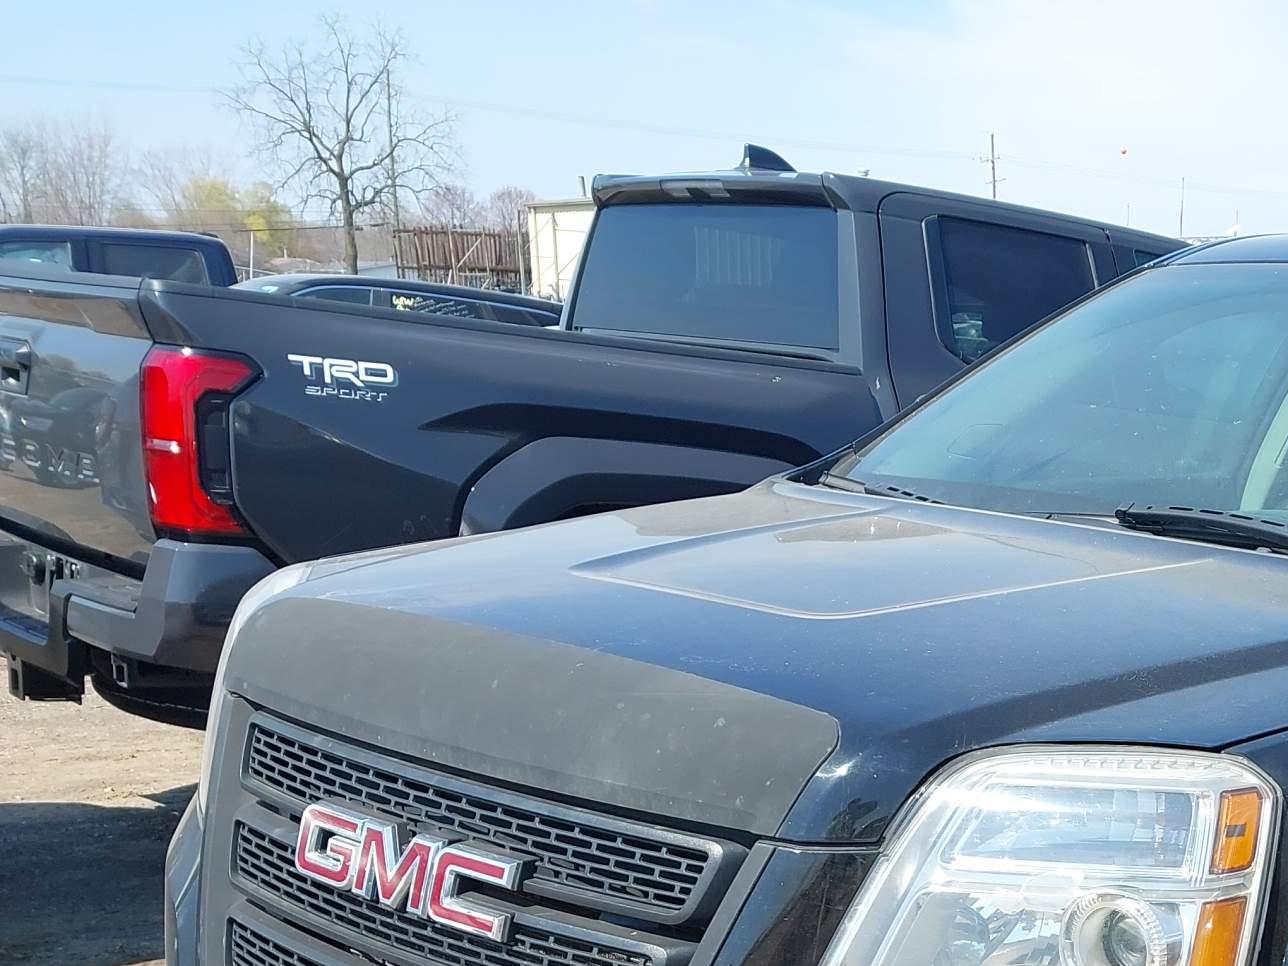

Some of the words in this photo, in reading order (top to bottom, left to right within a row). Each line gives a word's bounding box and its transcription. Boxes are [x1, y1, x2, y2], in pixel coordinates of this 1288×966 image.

[287, 353, 397, 387] TRD
[304, 384, 388, 402] SPORT
[296, 803, 522, 943] GMC
